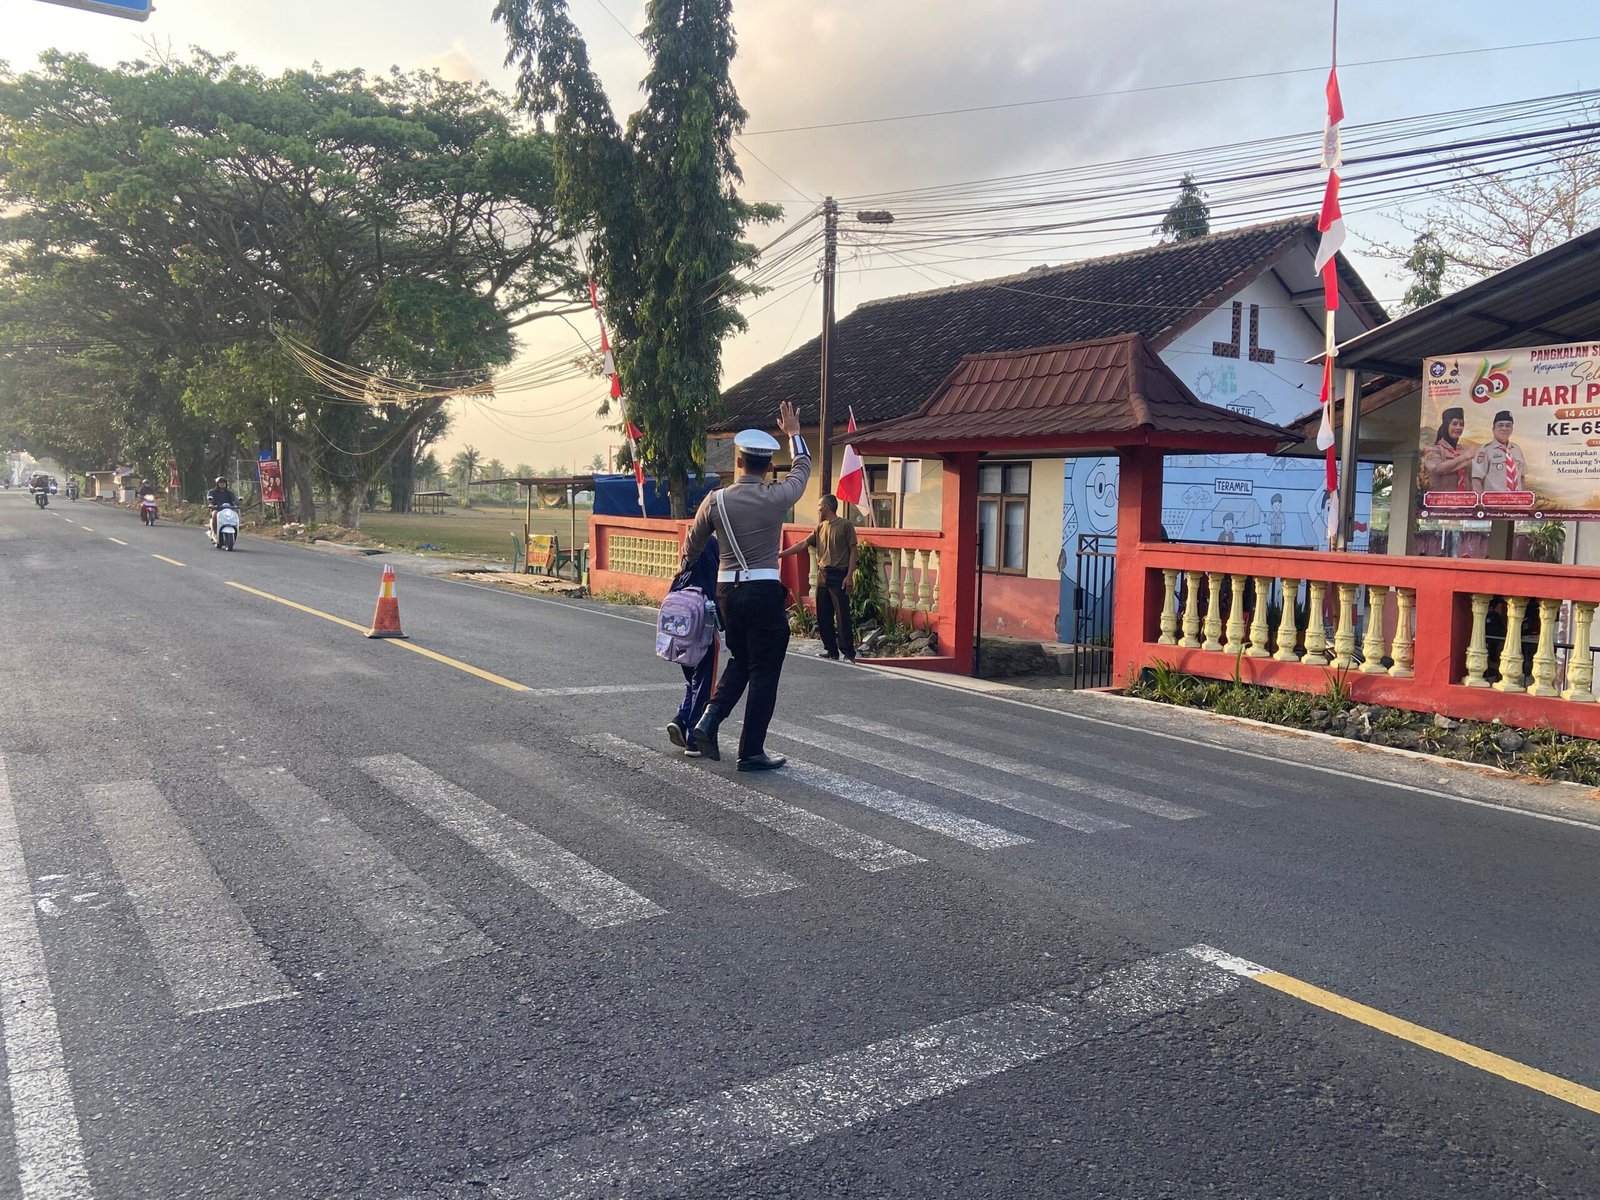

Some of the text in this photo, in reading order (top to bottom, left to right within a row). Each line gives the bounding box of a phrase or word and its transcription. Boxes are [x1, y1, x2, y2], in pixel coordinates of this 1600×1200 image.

[1531, 345, 1600, 362] PANGKALAN S
[1570, 360, 1600, 387] Sel
[1523, 384, 1577, 407] HARI
[1564, 410, 1575, 418] 14
[1549, 450, 1597, 458] Memantapkan
[1557, 467, 1583, 475] Menuju
[1217, 481, 1250, 492] TERAMPIL
